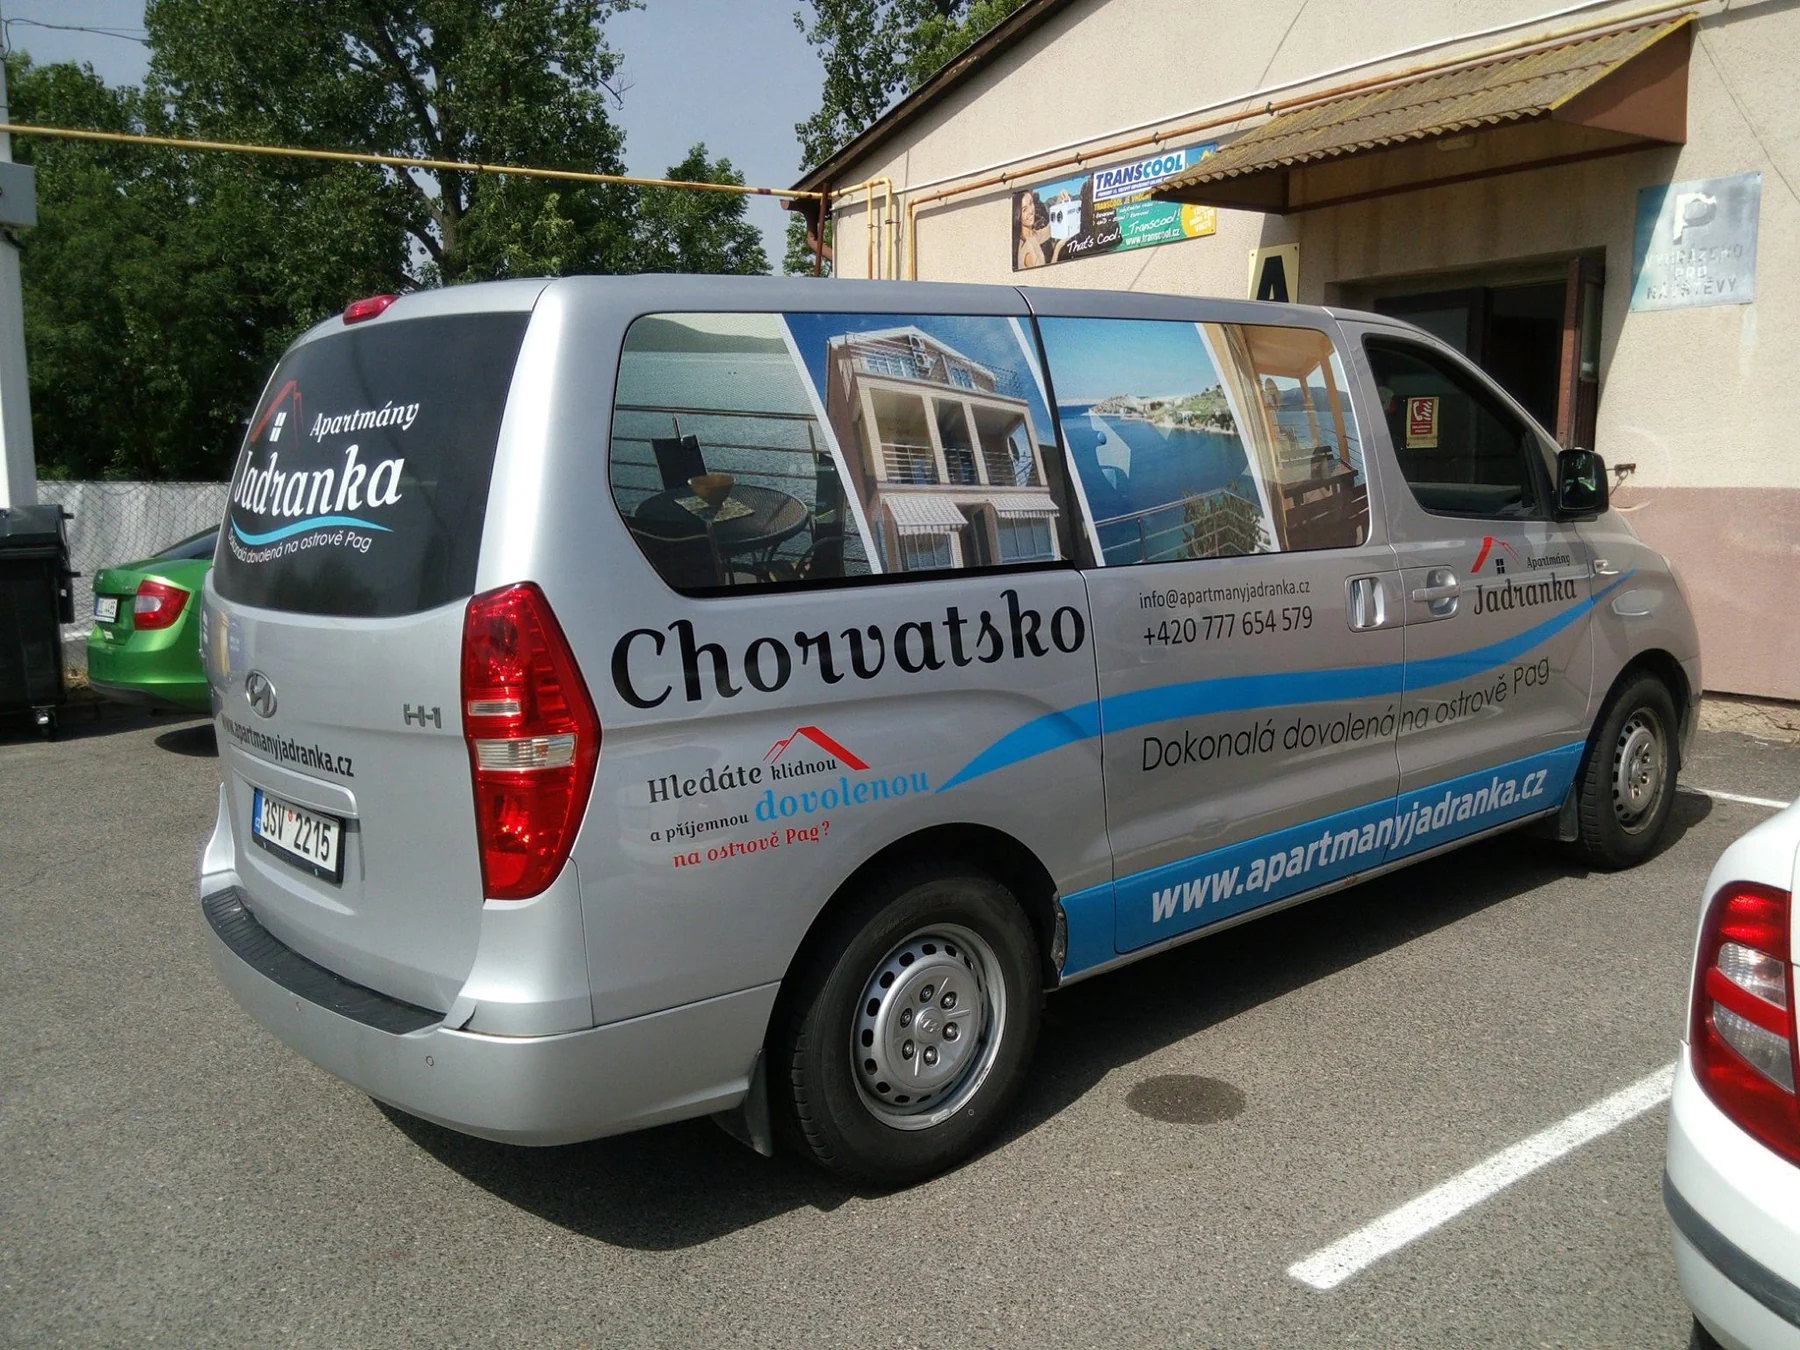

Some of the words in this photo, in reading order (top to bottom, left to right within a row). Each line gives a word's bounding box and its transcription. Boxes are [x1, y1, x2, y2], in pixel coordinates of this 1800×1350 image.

[1095, 154, 1183, 190] TRANSCOOL
[1067, 235, 1094, 254] That's
[1097, 226, 1122, 245] Cool!
[1126, 227, 1180, 246] www.transcool.cz
[1673, 192, 1717, 246] P
[309, 400, 420, 443] Apartmány
[234, 444, 405, 517] Jadranka
[284, 540, 299, 555] na
[301, 530, 343, 548] ostrově
[344, 531, 373, 553] Pag
[1526, 552, 1570, 570] Apartmány
[1139, 579, 1311, 609] info@apartmanyjadranka.cz
[1474, 572, 1577, 615] Jadranka
[1144, 618, 1197, 646] +420
[1202, 613, 1235, 640] 777
[1242, 609, 1277, 636] 654
[1282, 605, 1313, 632] 579
[611, 589, 1085, 709] Chorvatsko
[1142, 718, 1275, 772] Dokonalá
[1283, 704, 1396, 750] dovolená
[1400, 705, 1429, 733] na
[1435, 675, 1507, 723] ostrově
[1513, 656, 1550, 695] Pag
[221, 713, 354, 778] www.apartmanyjadranka.cz
[647, 764, 762, 804] Hledáte
[771, 759, 838, 781] klidnou
[650, 830, 661, 843] a
[665, 813, 749, 843] příjemnou
[755, 771, 930, 823] dovolenou
[263, 798, 286, 841] 3SV
[294, 812, 331, 862] 2215
[673, 850, 702, 869] na
[707, 831, 780, 862] ostrově
[1151, 768, 1548, 924] www.apartmanyjadranka.cz
